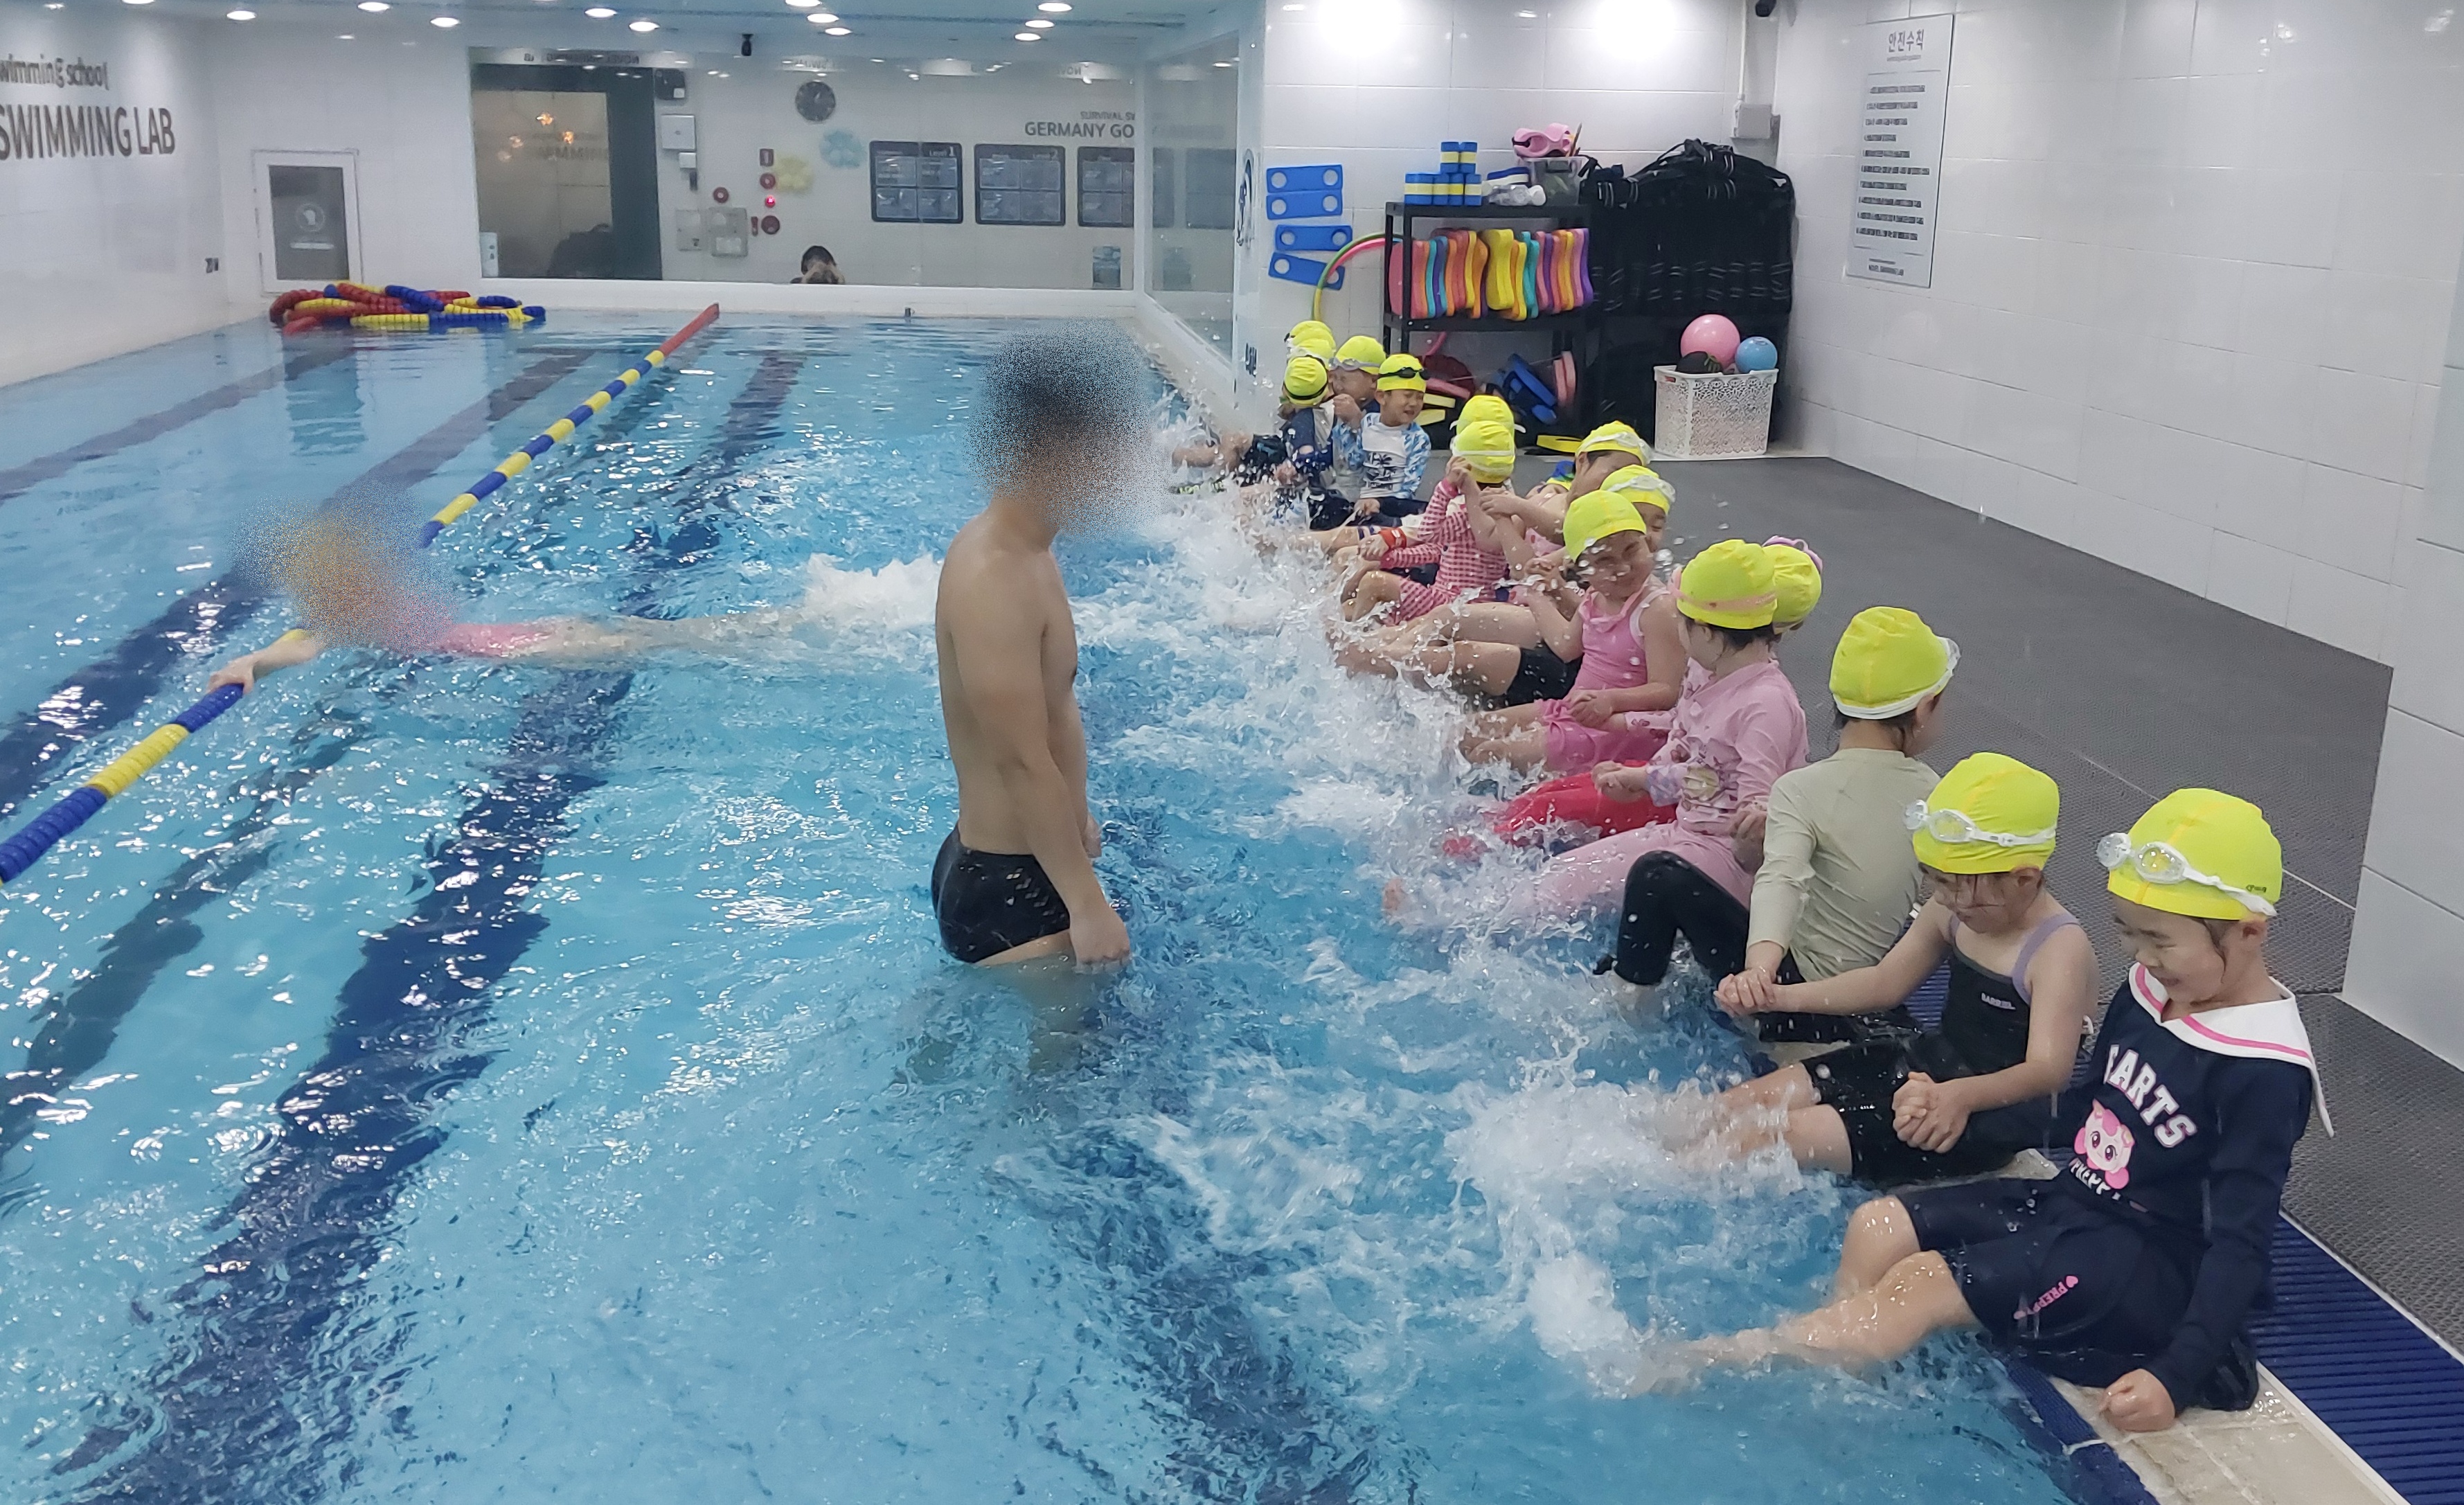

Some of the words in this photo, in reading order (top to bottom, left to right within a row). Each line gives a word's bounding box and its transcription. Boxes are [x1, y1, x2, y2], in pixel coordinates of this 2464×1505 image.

[66, 57, 109, 91] school
[0, 104, 132, 161] SWIMMING
[134, 107, 175, 154] LAB
[1025, 121, 1106, 138] GERMANY
[1110, 123, 1135, 139] GO
